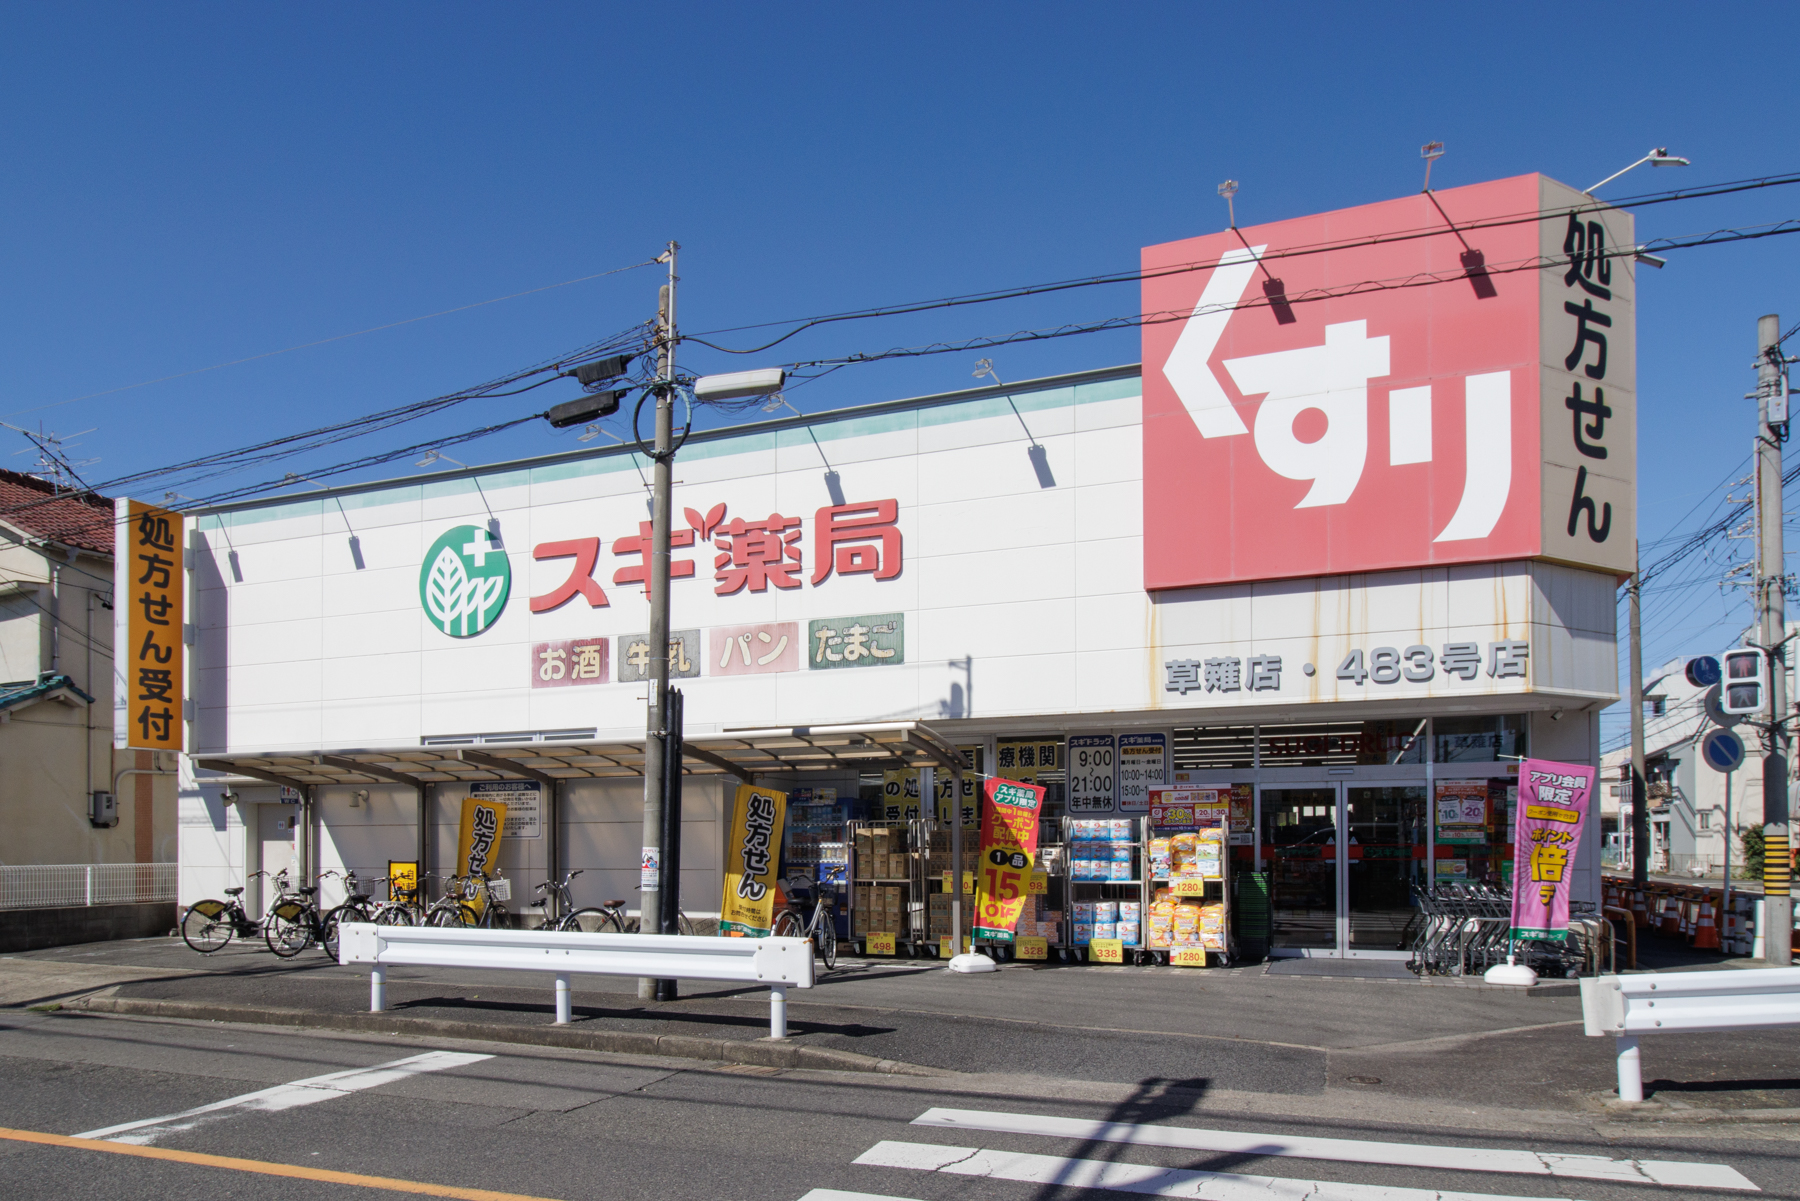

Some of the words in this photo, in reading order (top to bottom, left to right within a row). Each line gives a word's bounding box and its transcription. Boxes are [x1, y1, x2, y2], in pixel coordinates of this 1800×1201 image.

[1564, 208, 1612, 544] 処方せん
[1161, 243, 1513, 543] くすり
[529, 498, 903, 613] スギ薬局
[137, 512, 175, 742] 処方せん受付
[719, 631, 789, 669] パン
[814, 621, 899, 663] たまご
[539, 644, 601, 681] お酒
[626, 637, 692, 676] 牛乳
[1070, 736, 1114, 746] スギドラッグ
[1121, 736, 1152, 745] スギ薬局
[1079, 750, 1113, 768] 9:00
[1121, 746, 1163, 756] 処方せん受付
[1071, 775, 1113, 793] 21:00
[1530, 771, 1588, 789] アプリ会員
[1000, 785, 1034, 799] スギ薬局
[1537, 785, 1574, 806] 限定
[996, 793, 1036, 809] アプリ限定
[1071, 795, 1113, 810] 年中無休
[991, 813, 1035, 830] クーポン
[1076, 822, 1083, 832] 2
[1094, 822, 1101, 832] 2
[1114, 822, 1121, 832] 2
[993, 825, 1030, 843] 配信中
[1531, 828, 1574, 844] ポイント
[462, 804, 497, 900] 処方せん
[737, 793, 777, 901] 処方せん
[1075, 862, 1082, 872] 2
[1095, 862, 1102, 872] 2
[1115, 862, 1122, 873] 2
[1530, 843, 1569, 883] 倍
[1076, 905, 1083, 915] 2
[1096, 905, 1103, 915] 2
[1125, 905, 1132, 915] 2
[984, 930, 1010, 939] スギ薬局
[1077, 925, 1084, 936] 2
[1097, 925, 1104, 935] 2
[1121, 925, 1128, 936] 2
